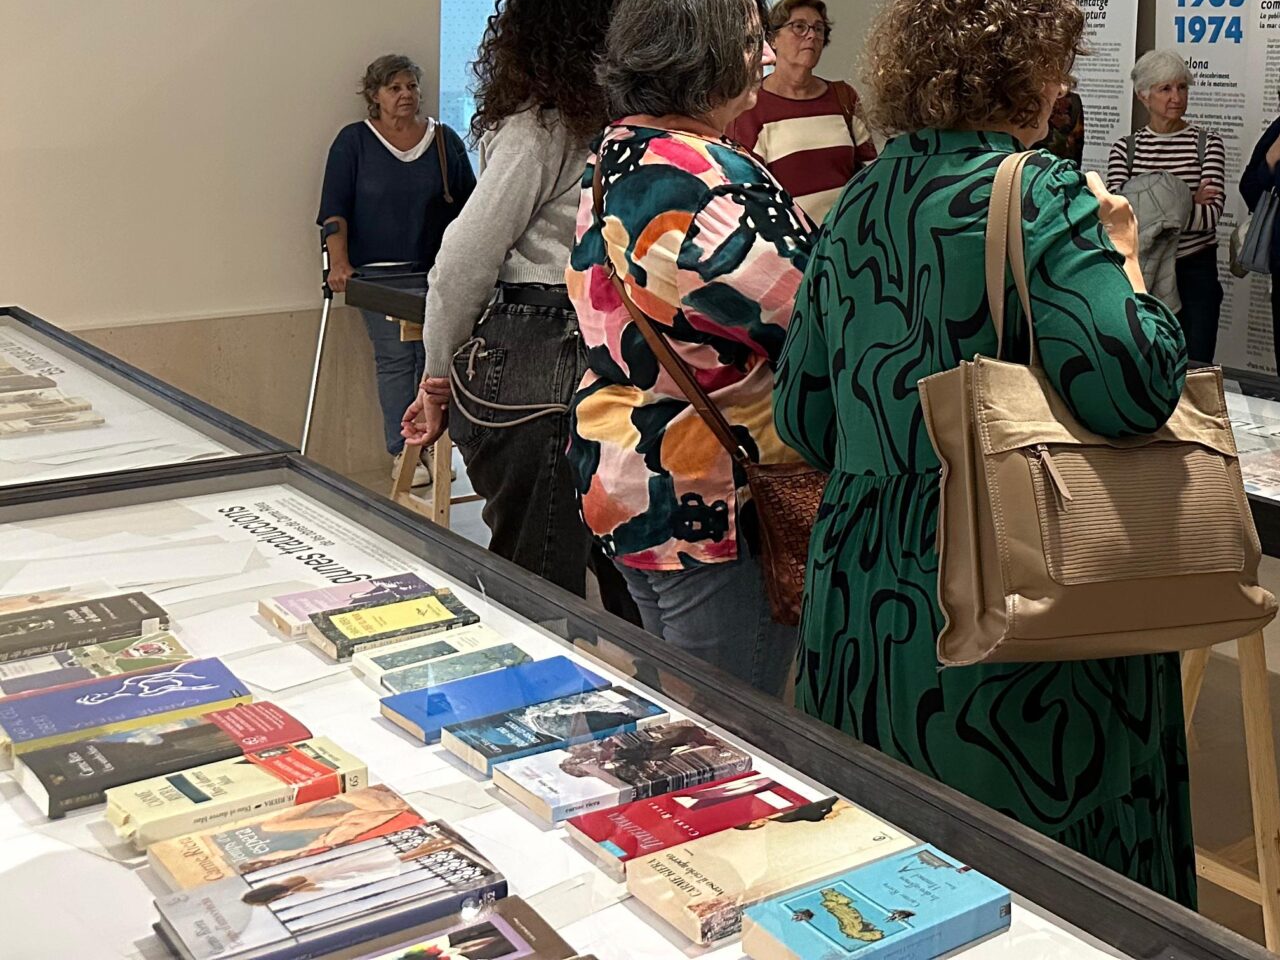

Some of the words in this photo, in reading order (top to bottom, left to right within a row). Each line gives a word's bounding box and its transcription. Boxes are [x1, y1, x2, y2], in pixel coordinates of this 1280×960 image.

[1260, 0, 1280, 10] com
[1174, 15, 1243, 43] 1974
[218, 505, 313, 556] traduccions
[296, 552, 373, 584] gunes
[234, 827, 270, 856] espera
[647, 858, 672, 878] RIERA
[669, 875, 703, 898] CARME
